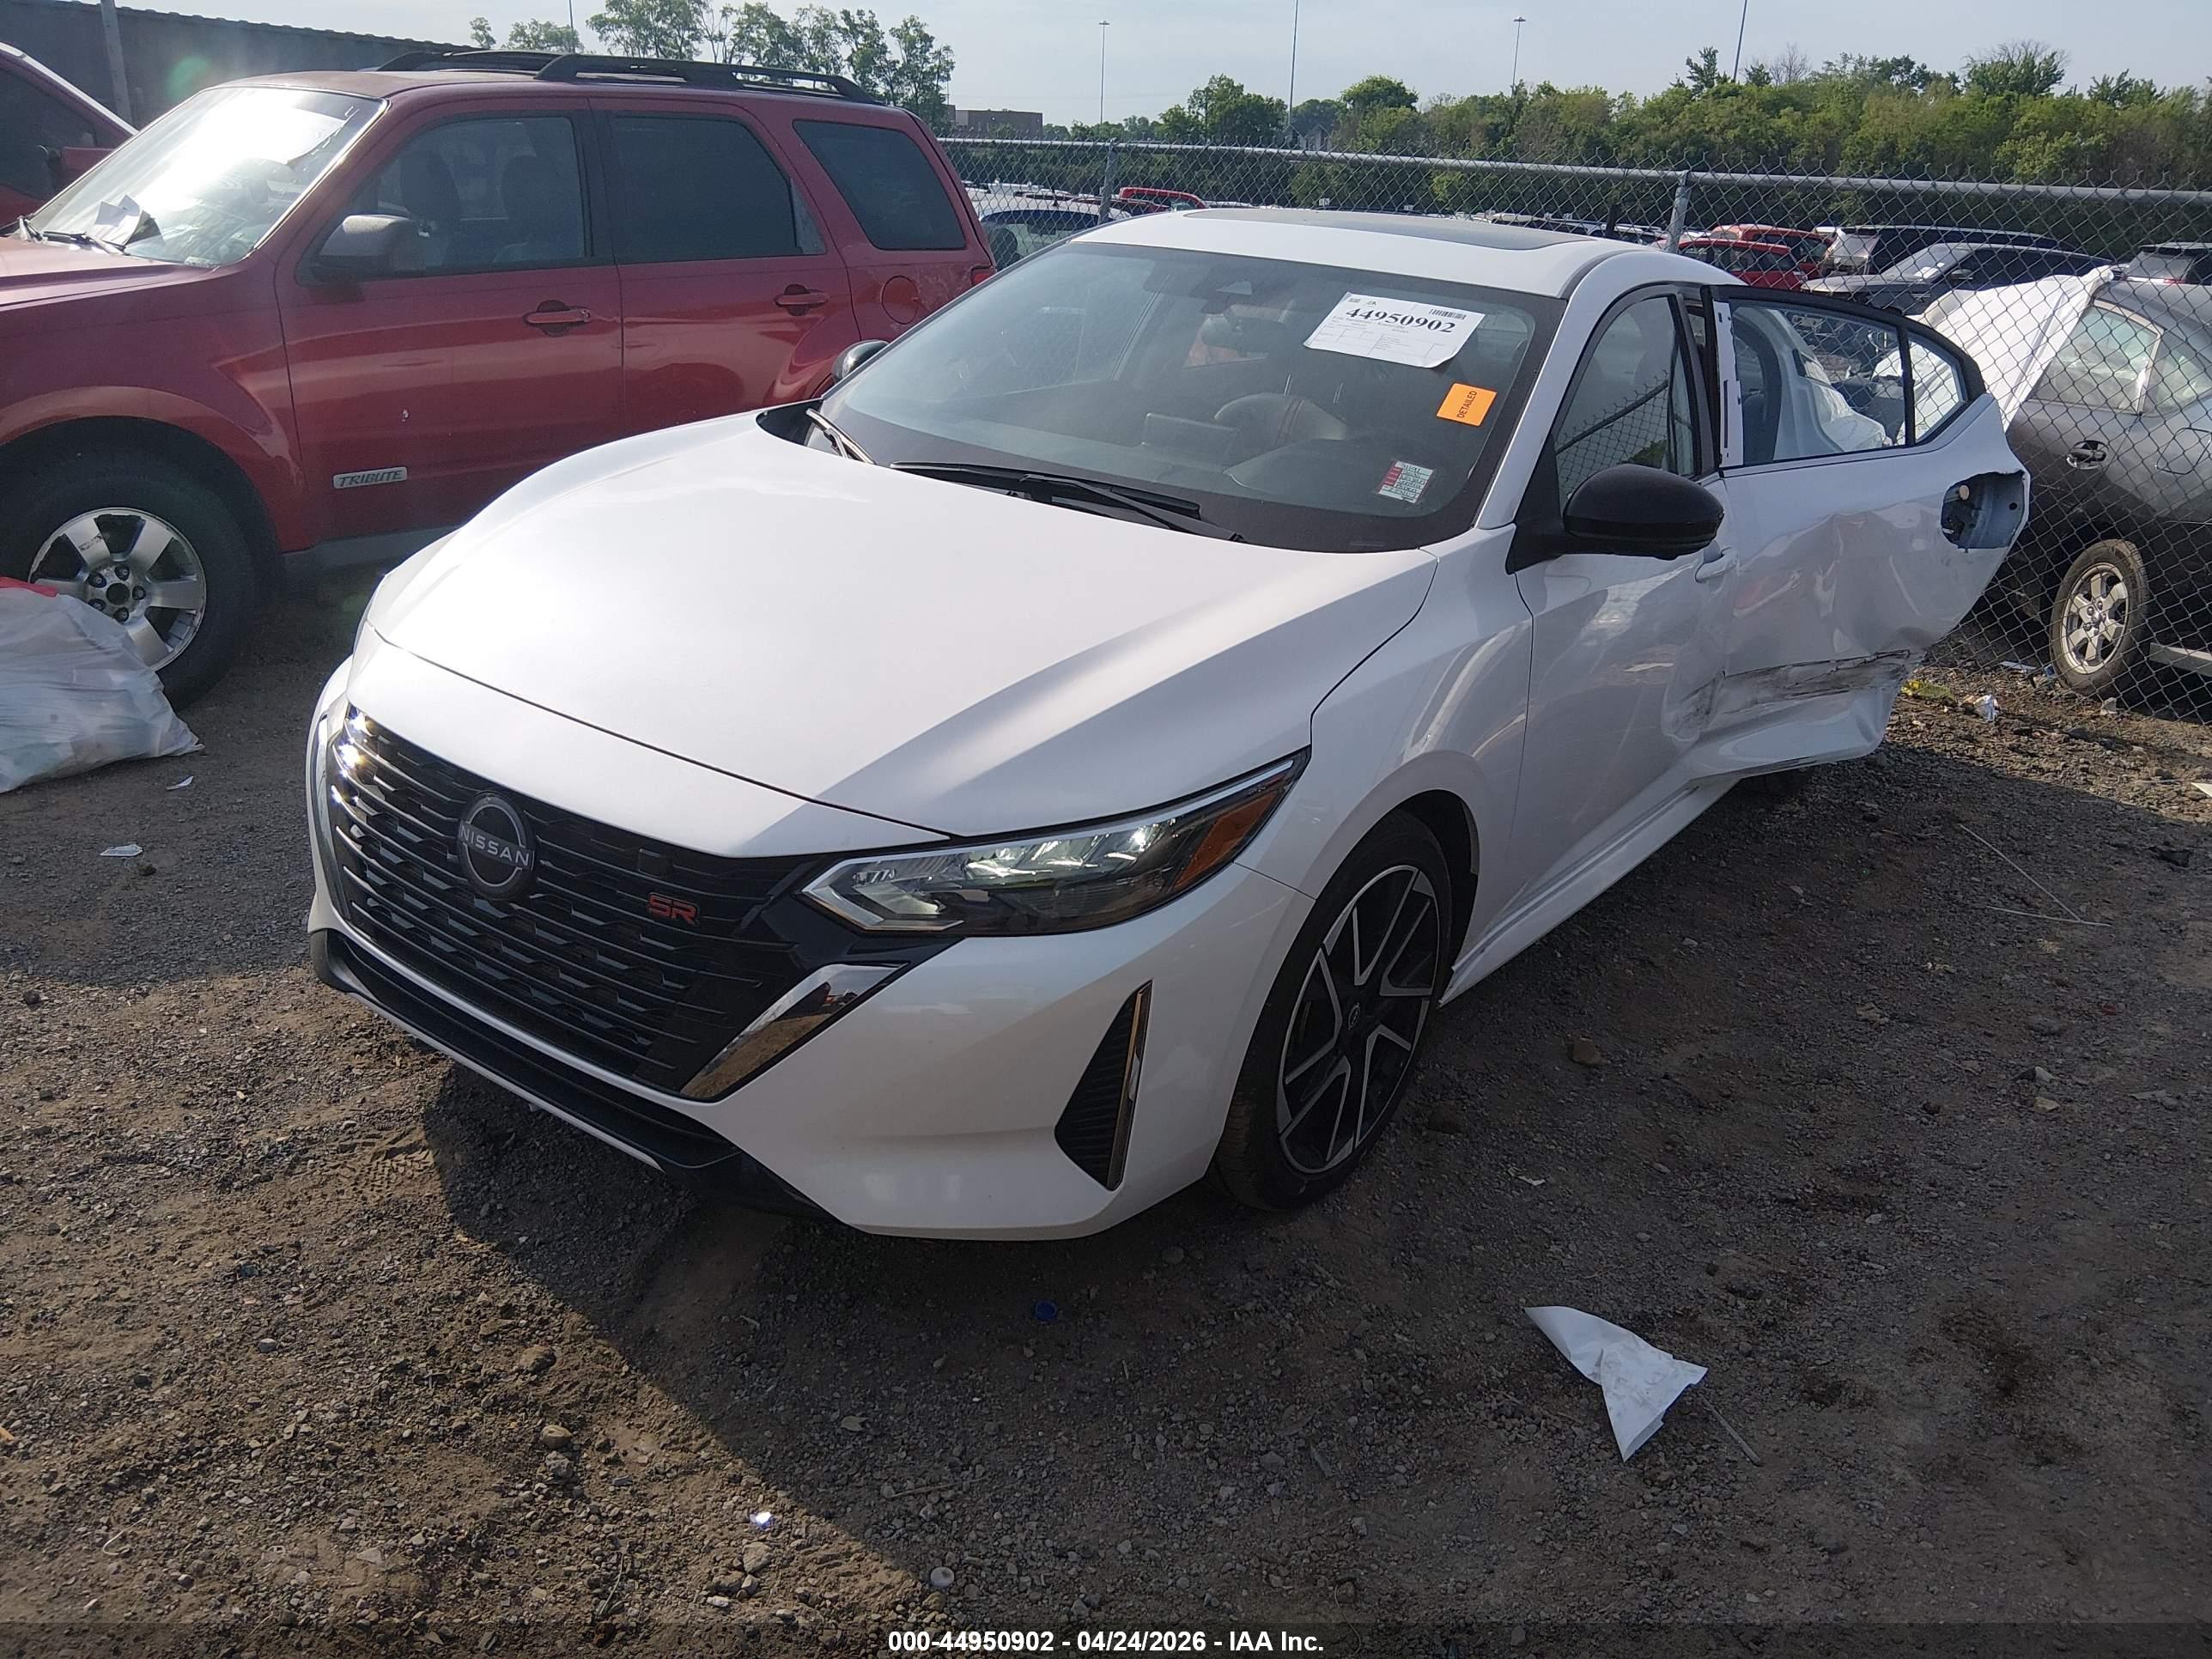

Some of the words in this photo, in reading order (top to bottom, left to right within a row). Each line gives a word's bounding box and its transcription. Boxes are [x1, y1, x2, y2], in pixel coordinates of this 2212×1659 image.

[1346, 307, 1456, 333] 44950902
[1456, 390, 1478, 419] DETAILED
[338, 470, 403, 487] TRIBUTE
[459, 824, 530, 866] NISSAN
[647, 892, 700, 926] SR
